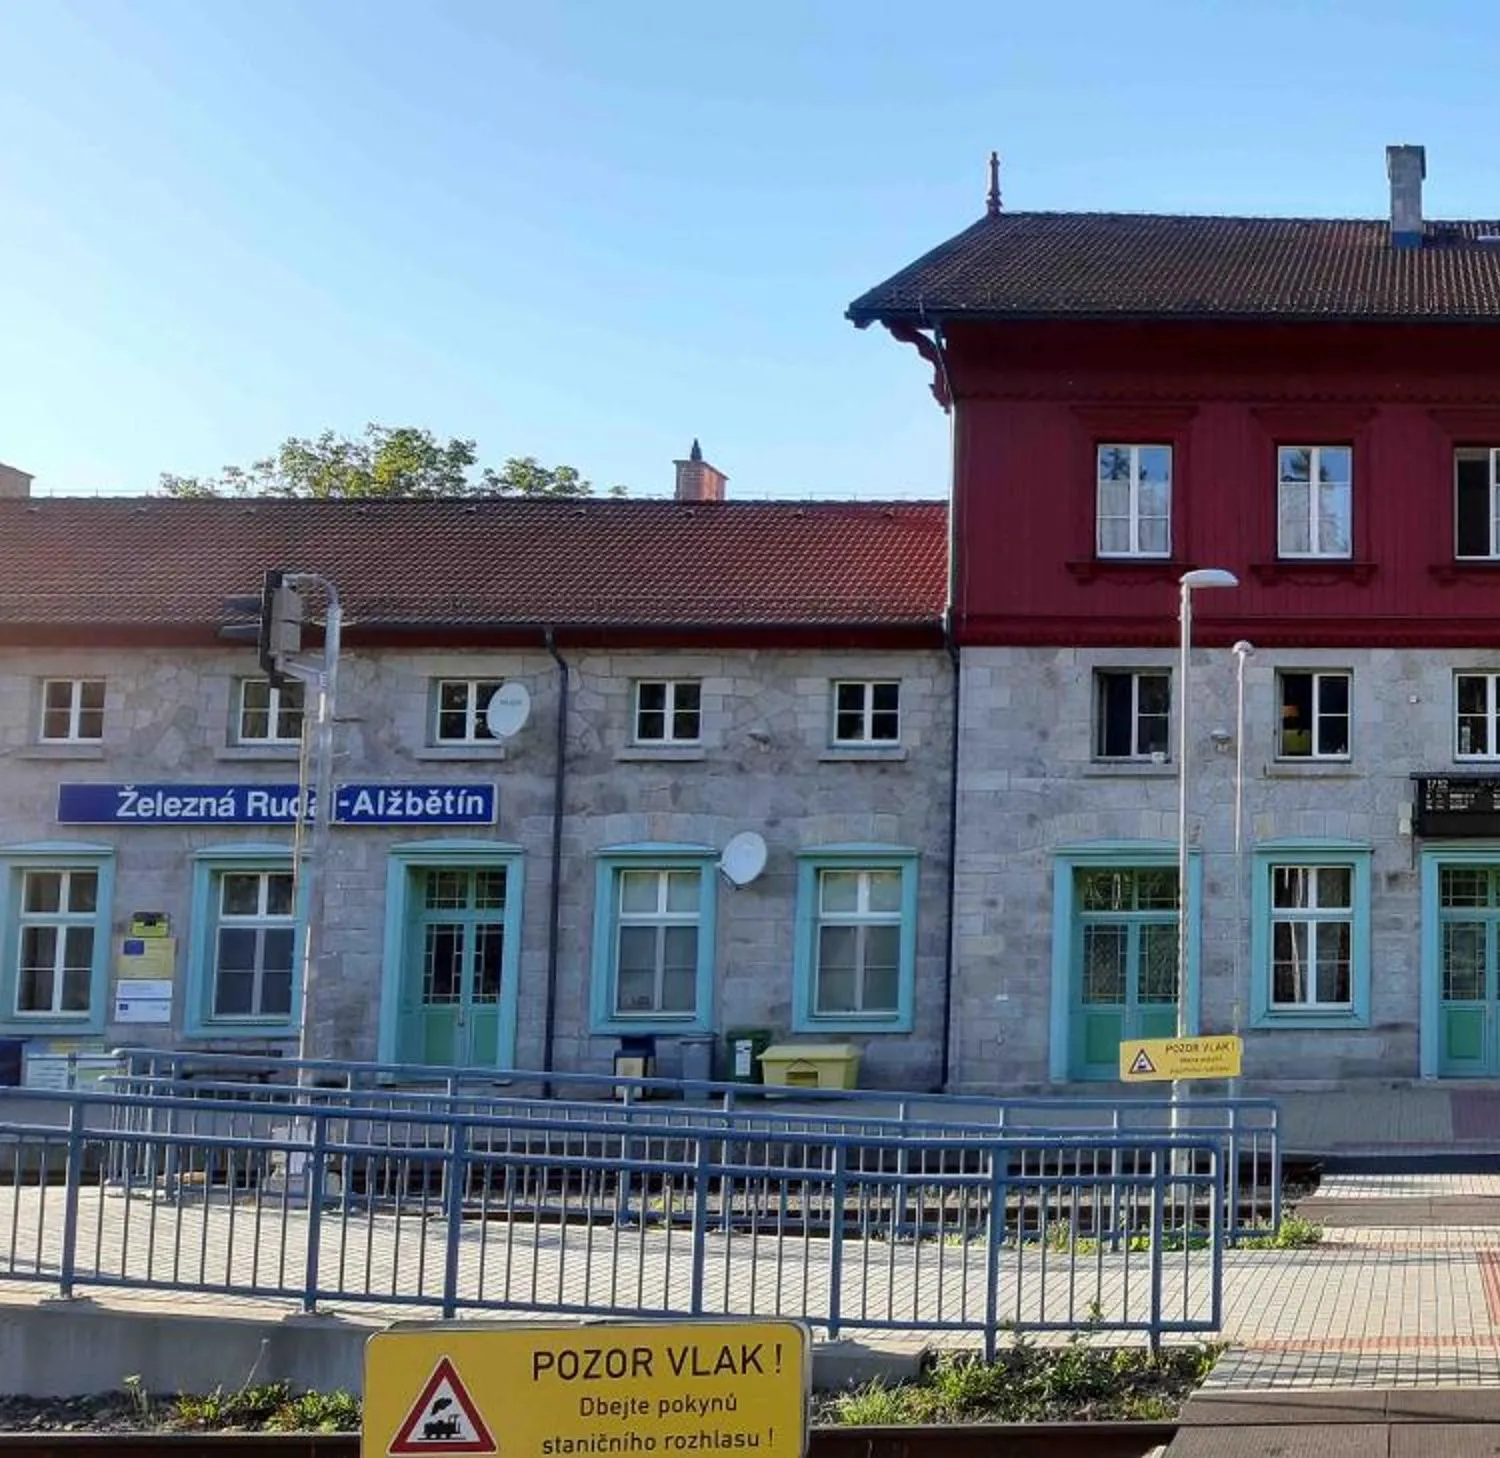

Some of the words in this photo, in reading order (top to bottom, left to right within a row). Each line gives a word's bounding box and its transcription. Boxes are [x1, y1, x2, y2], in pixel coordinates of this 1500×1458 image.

[116, 785, 235, 817] Železná
[533, 1347, 653, 1382] POZOR
[580, 1397, 649, 1421] Dbejte
[658, 1393, 737, 1419] pokynů
[542, 1431, 657, 1455] staničního
